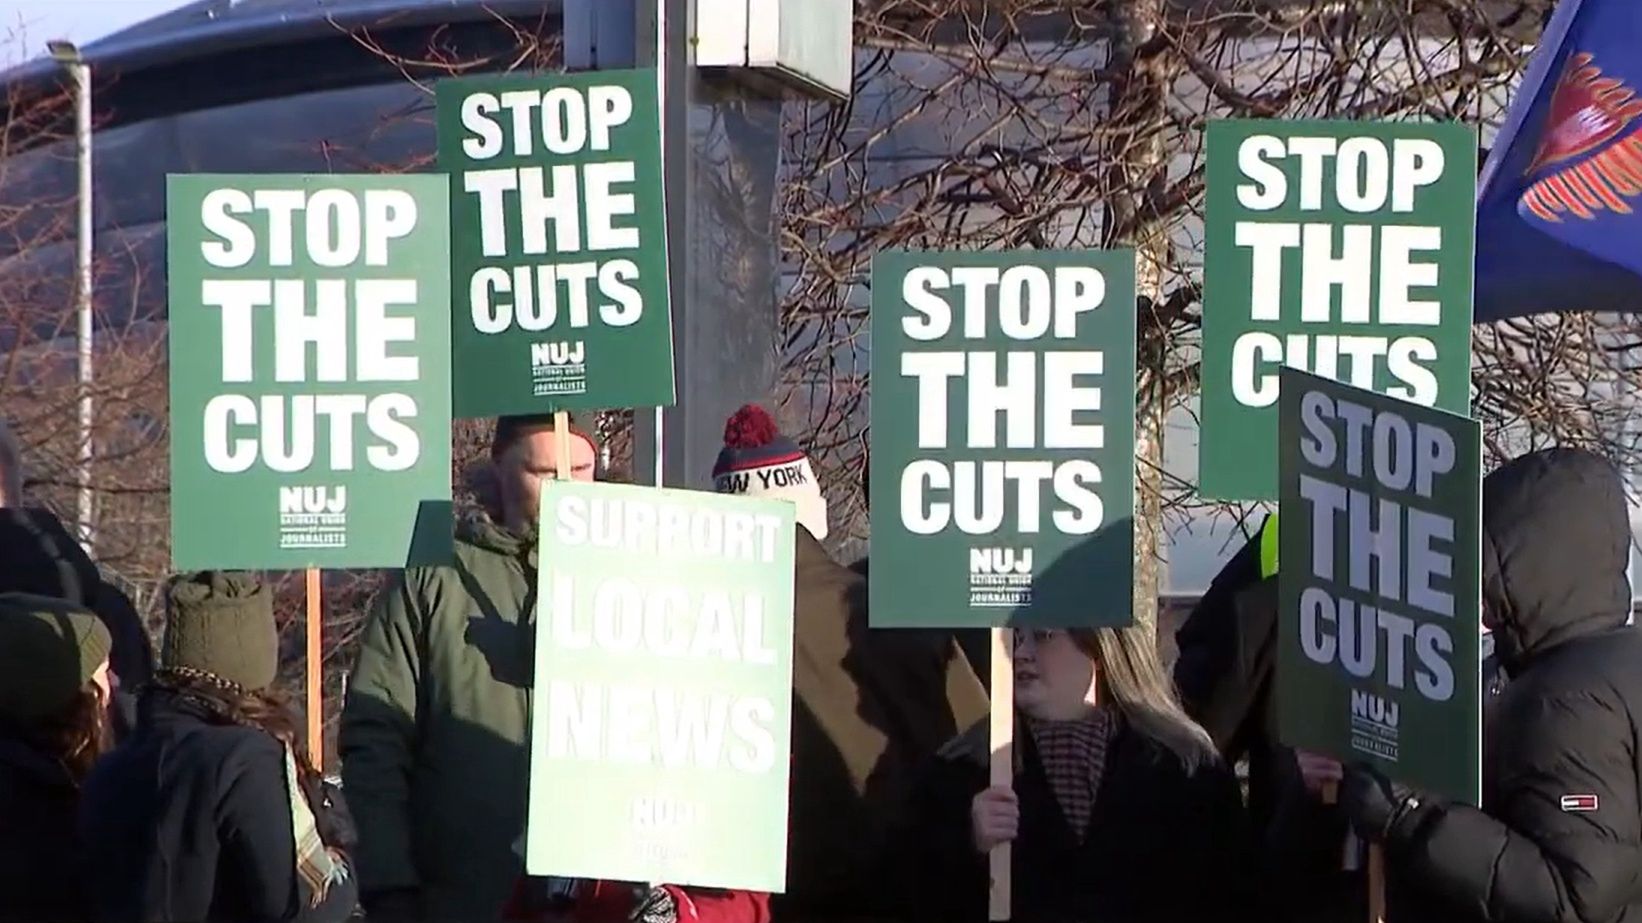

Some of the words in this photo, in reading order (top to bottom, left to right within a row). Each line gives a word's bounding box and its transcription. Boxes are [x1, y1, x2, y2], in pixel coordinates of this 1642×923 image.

[461, 85, 633, 159] STOP
[464, 161, 640, 257] THE
[1236, 134, 1445, 213] STOP
[201, 188, 418, 268] STOP
[470, 258, 643, 334] CUTS
[901, 264, 1106, 340] STOP
[1235, 222, 1442, 326] THE
[202, 278, 420, 382] THE
[531, 341, 585, 366] NUJ
[900, 351, 1105, 449] THE
[1231, 332, 1439, 408] CUTS
[203, 392, 421, 473] CUTS
[1300, 390, 1457, 498] STOP
[279, 485, 347, 513] NUJ
[757, 464, 808, 490] YORK
[900, 459, 1104, 535] CUTS
[555, 495, 781, 563] SUPPORT
[969, 547, 1033, 573] NUJ
[1300, 474, 1455, 618] THE
[551, 568, 778, 666] LOCAL
[1300, 586, 1456, 702] CUTS
[546, 680, 776, 774] NEWS
[1351, 687, 1399, 728] NUJ
